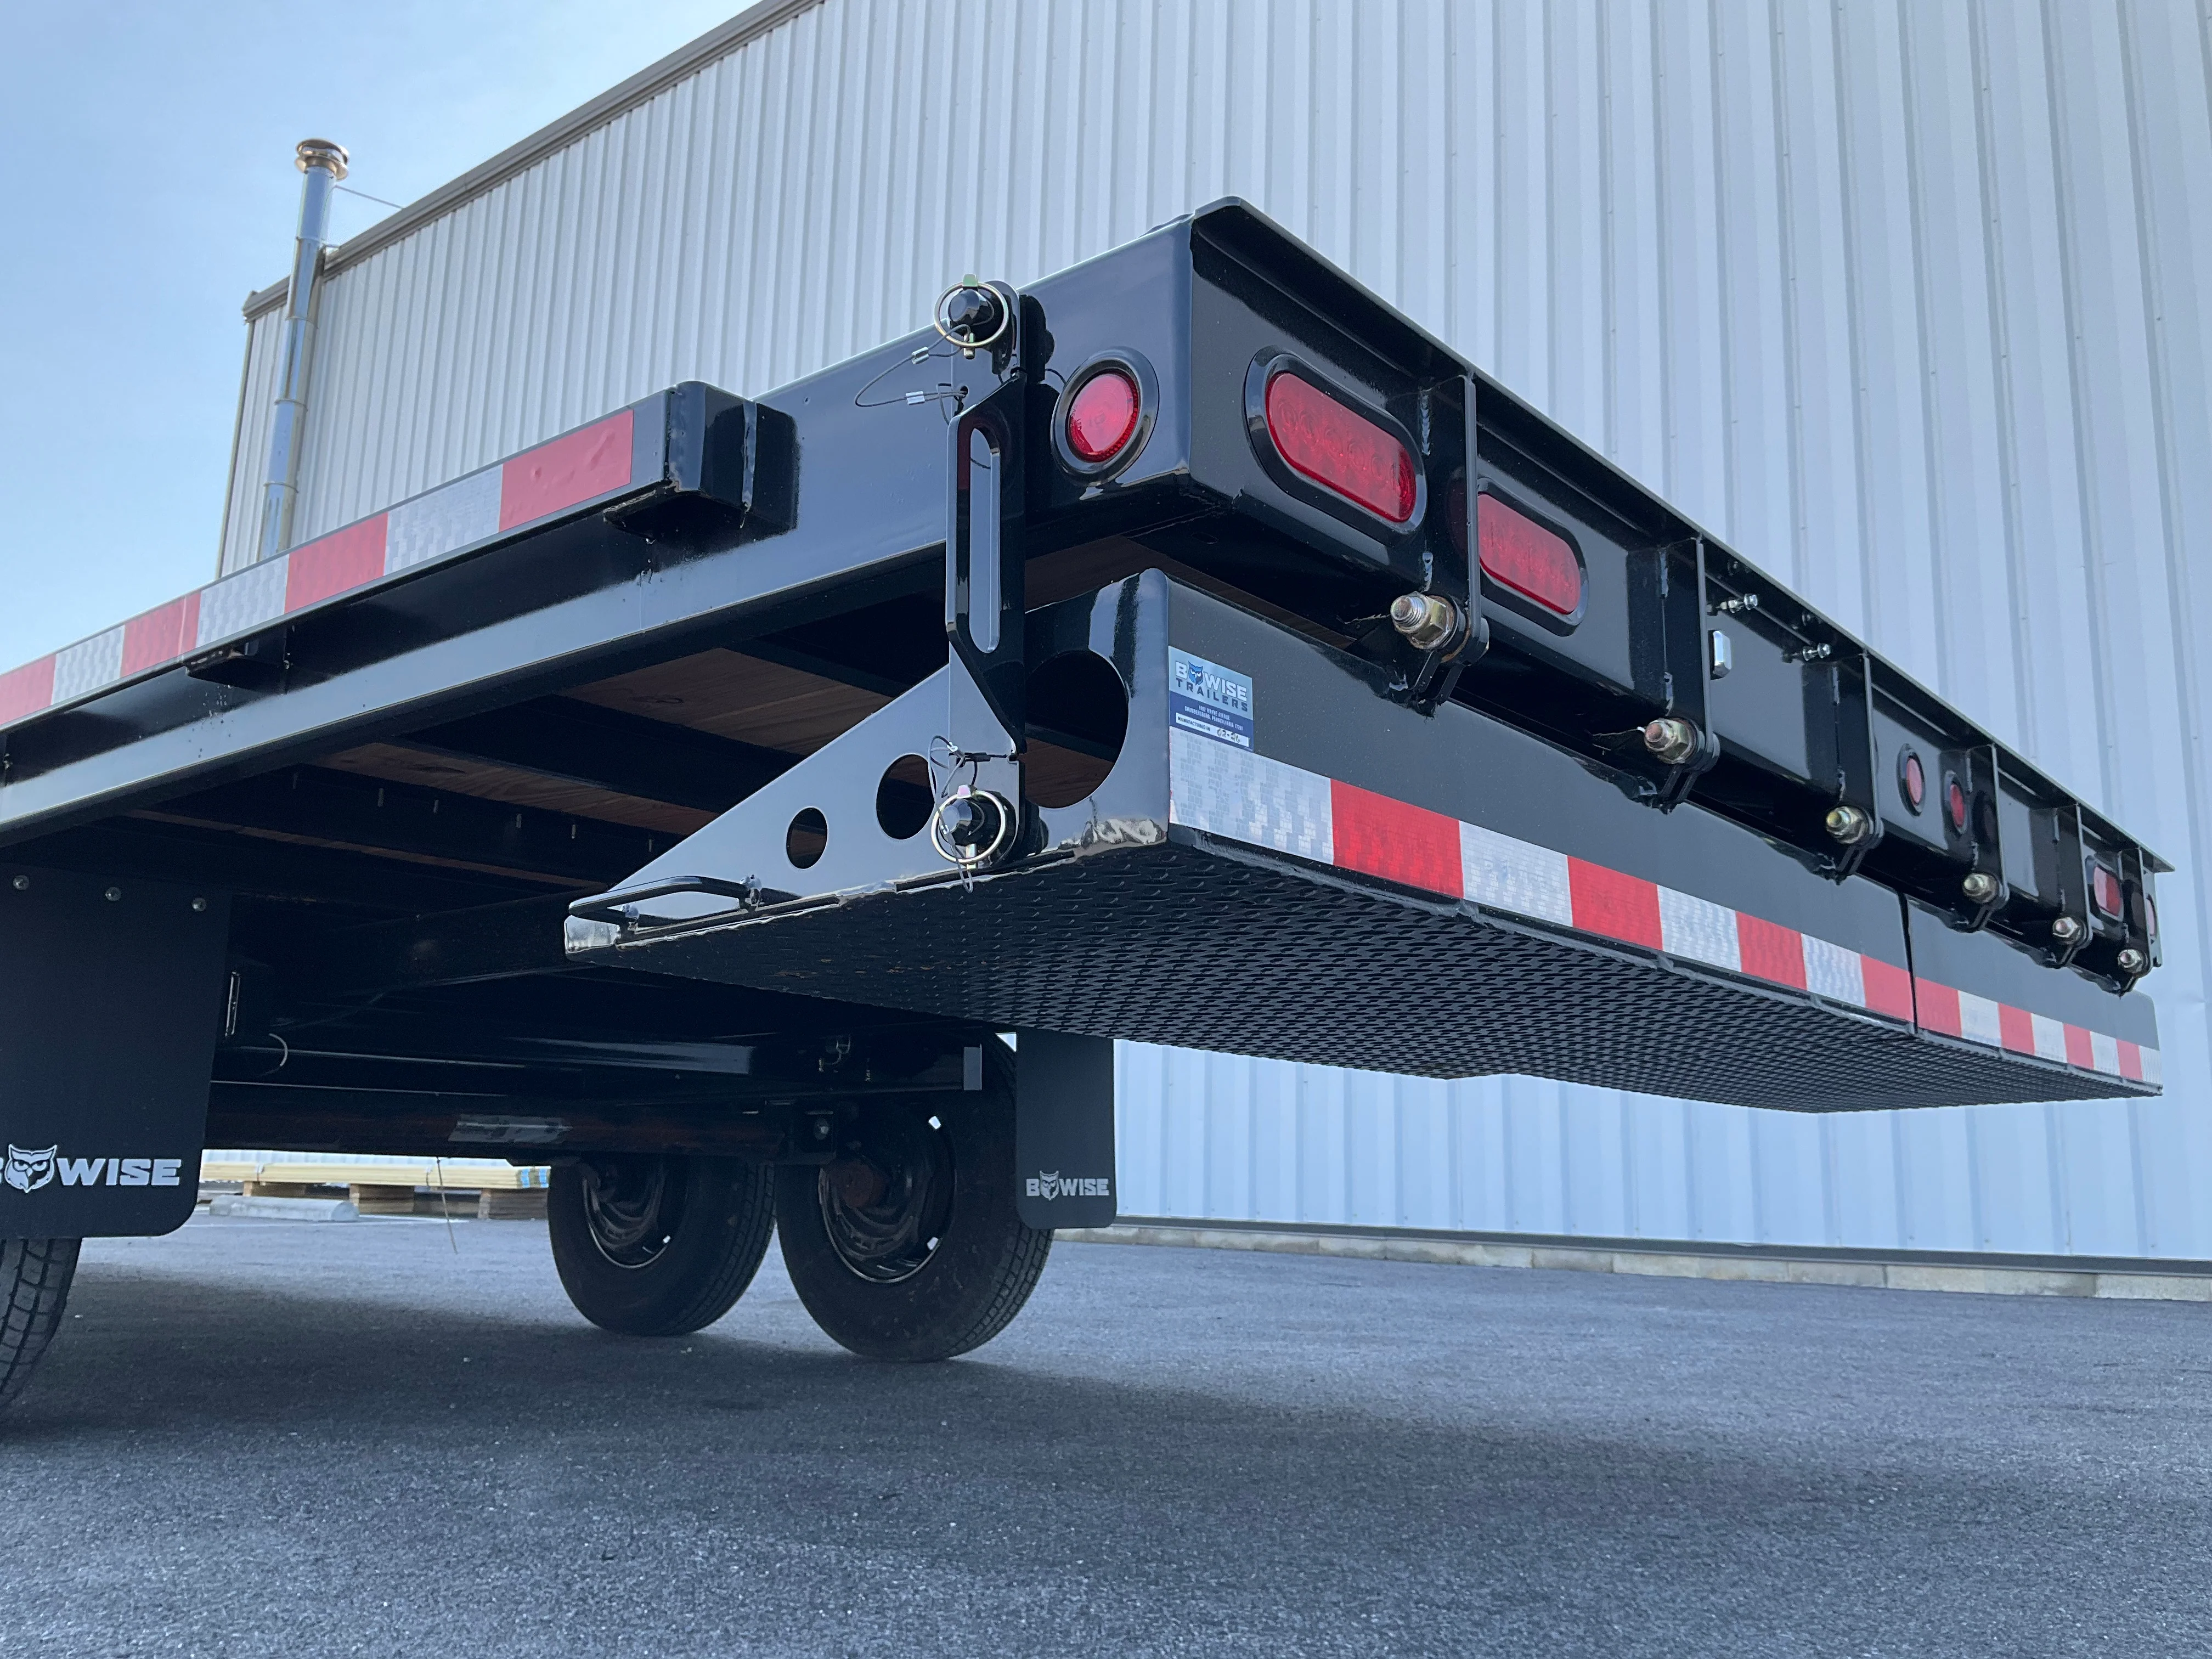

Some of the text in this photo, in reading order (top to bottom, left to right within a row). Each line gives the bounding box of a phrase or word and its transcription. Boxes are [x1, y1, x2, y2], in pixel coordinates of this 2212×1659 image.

[1176, 678, 1248, 712] TRAILERS
[1177, 716, 1206, 730] MANUFACTURED
[0, 1157, 182, 1187] WISE
